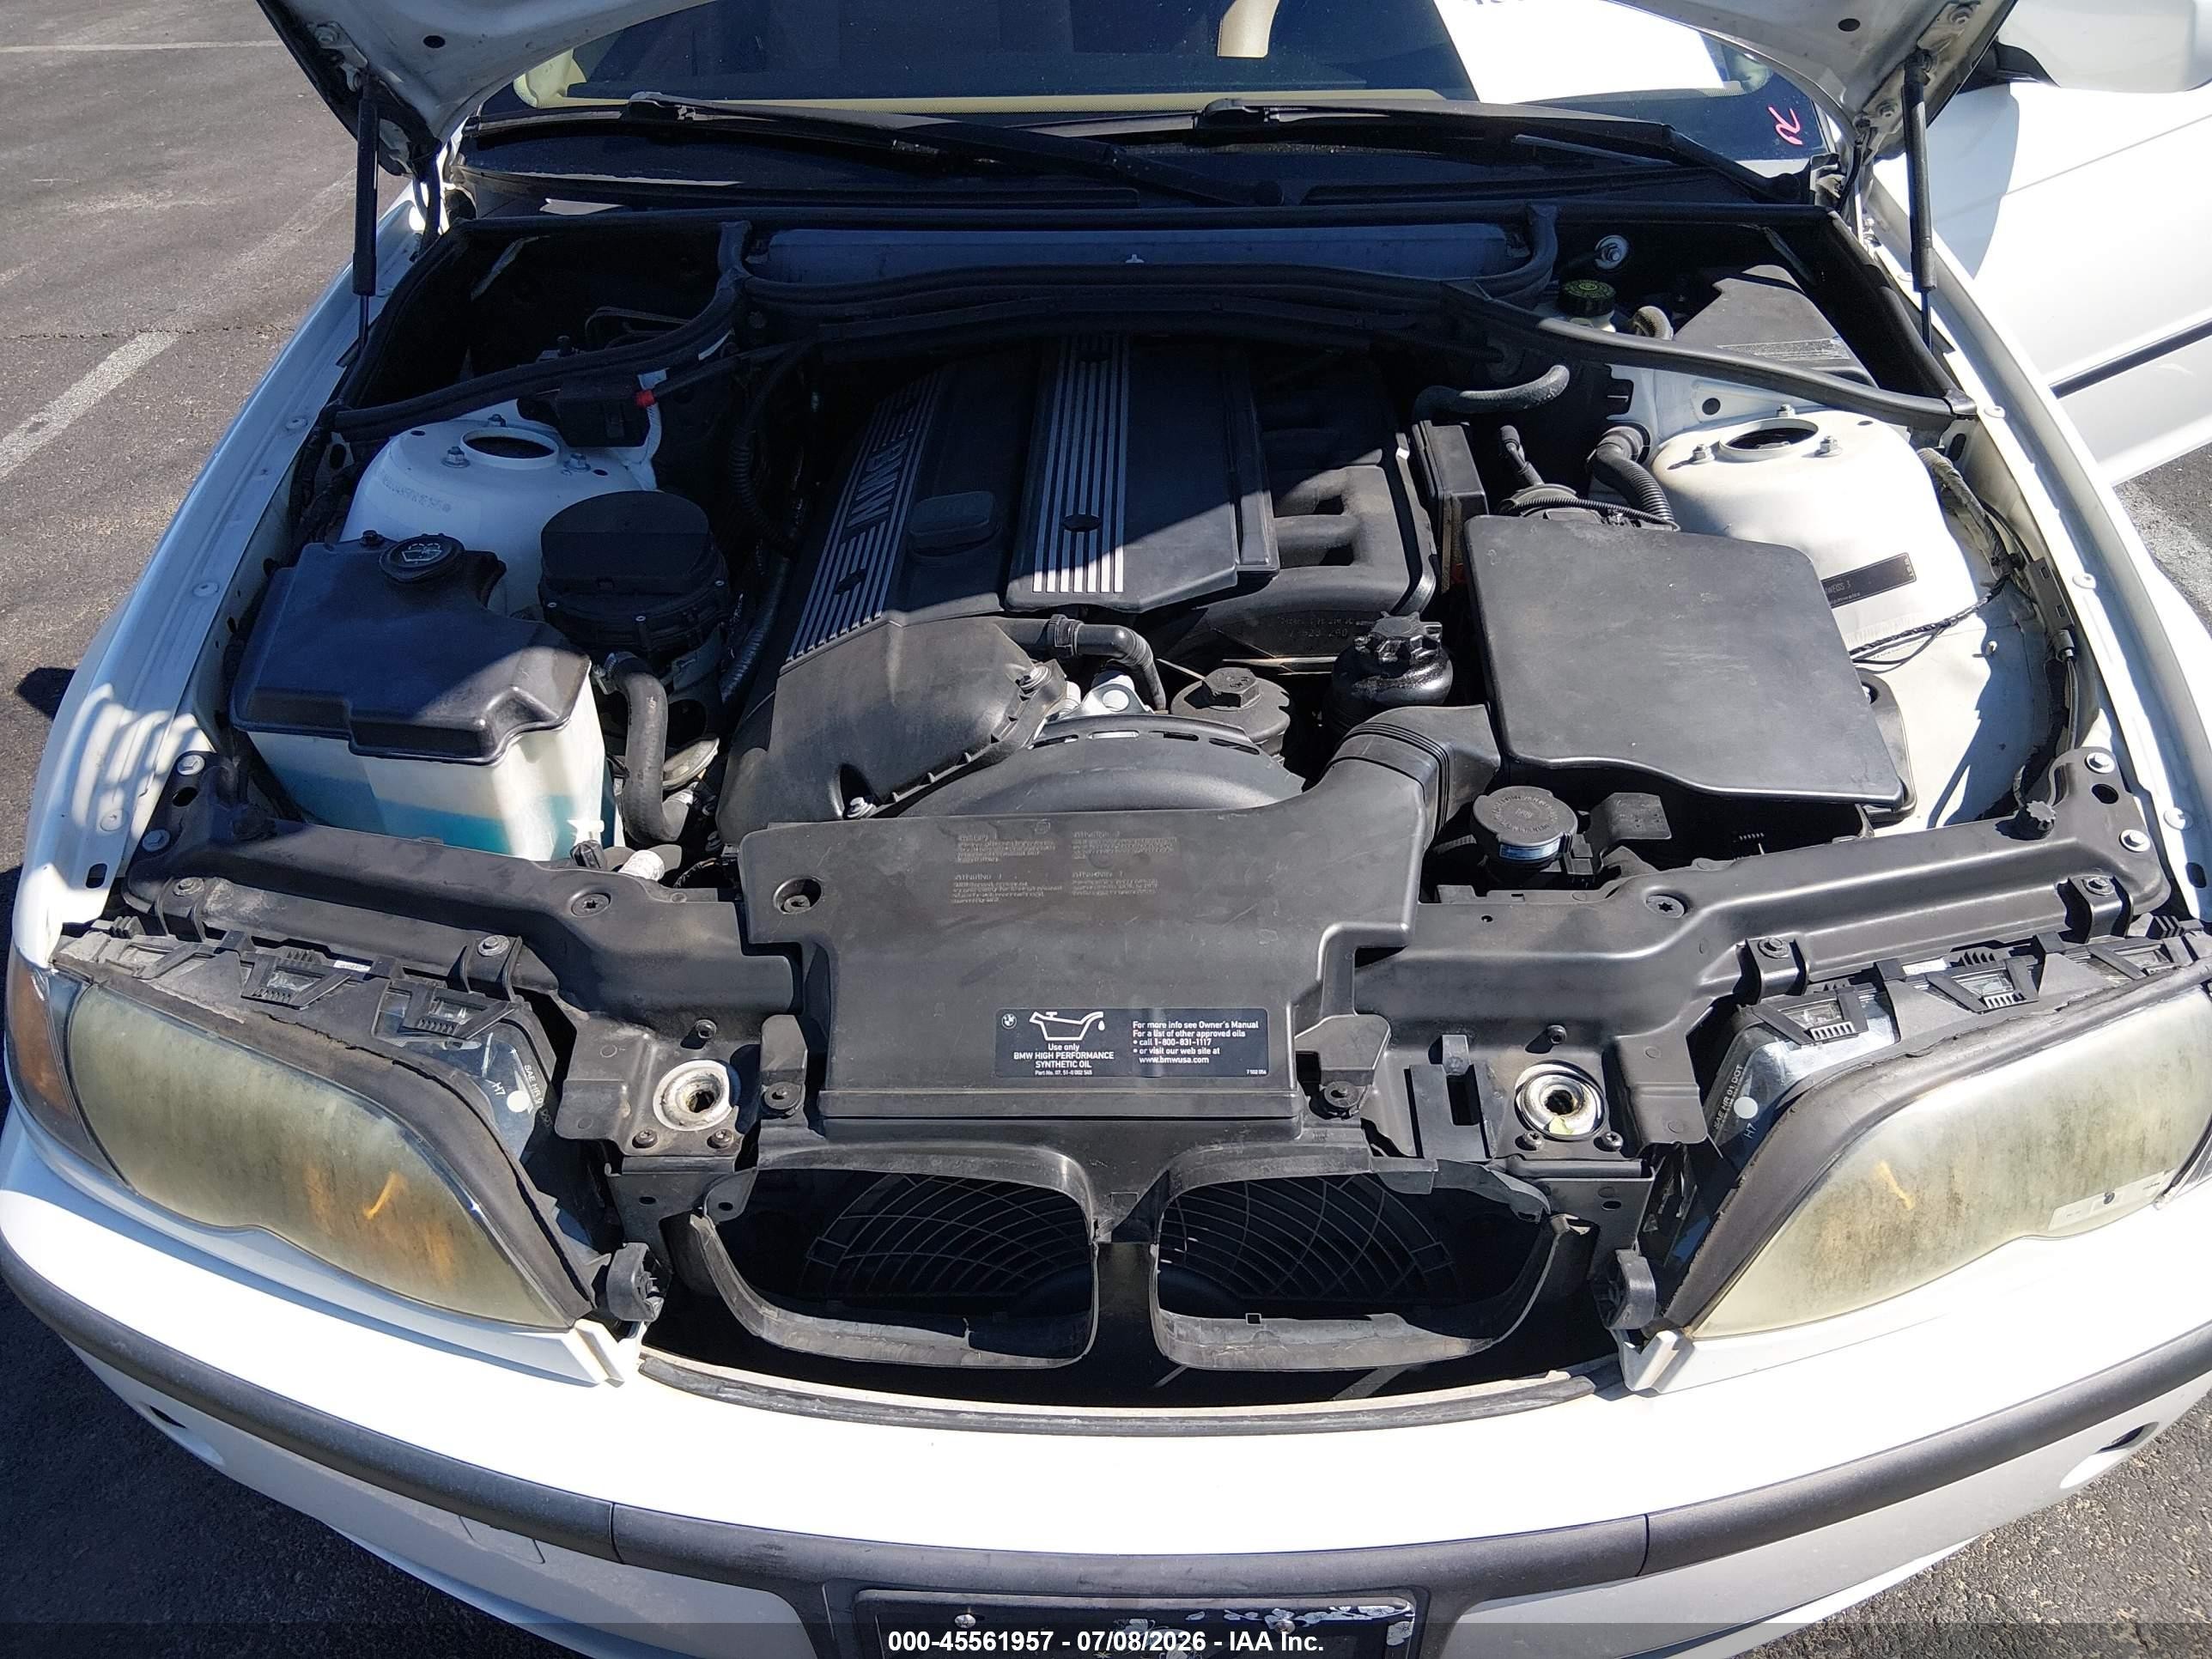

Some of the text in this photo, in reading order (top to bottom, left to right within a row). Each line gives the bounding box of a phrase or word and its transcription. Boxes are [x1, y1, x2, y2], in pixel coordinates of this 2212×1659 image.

[848, 439, 908, 528] BMW
[1133, 1020, 1146, 1029] For
[1168, 1020, 1183, 1029] info
[1198, 1020, 1231, 1029] Owner's
[1231, 1020, 1259, 1029] Manual
[1153, 1029, 1166, 1037] list
[1166, 1029, 1175, 1037] of
[1175, 1029, 1195, 1037] other
[1195, 1029, 1231, 1039] approved
[1231, 1029, 1246, 1037] oils
[1139, 1037, 1212, 1046] call 1-800-831-1117
[1048, 1042, 1080, 1052] Use only
[1139, 1047, 1148, 1055] or
[1148, 1046, 1165, 1055] visit
[1180, 1047, 1196, 1055] web
[1197, 1046, 1212, 1055] site
[1212, 1047, 1220, 1055] at
[1013, 1051, 1115, 1060] BMW HIGH PERFORMANCE
[1139, 1055, 1210, 1065] www.bmwusa.com
[1035, 1060, 1092, 1068] SYNTHETIC OIL
[524, 1065, 537, 1081] SAE
[532, 1083, 541, 1097] HR
[492, 1081, 507, 1097] H7
[1713, 1110, 1724, 1129] SAE
[1721, 1097, 1730, 1111] HR
[1731, 1064, 1744, 1085] DOT
[1743, 1122, 1757, 1139] H7
